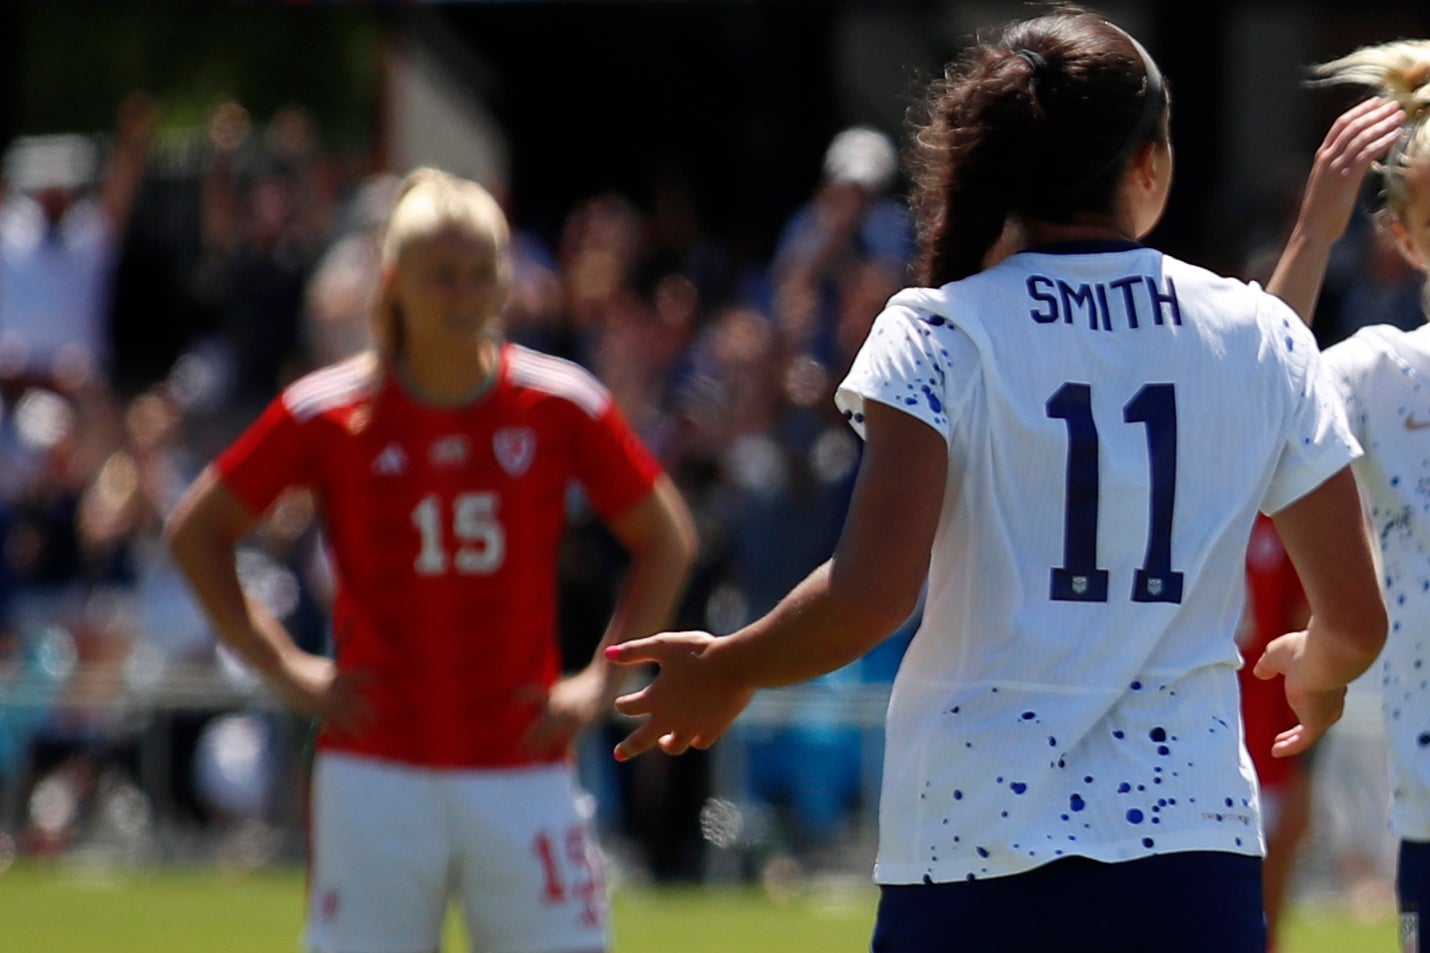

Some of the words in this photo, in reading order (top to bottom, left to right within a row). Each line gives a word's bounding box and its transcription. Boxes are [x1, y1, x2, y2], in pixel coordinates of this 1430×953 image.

[1026, 274, 1182, 331] SMITH
[410, 492, 505, 577] 15
[1045, 381, 1184, 604] 11
